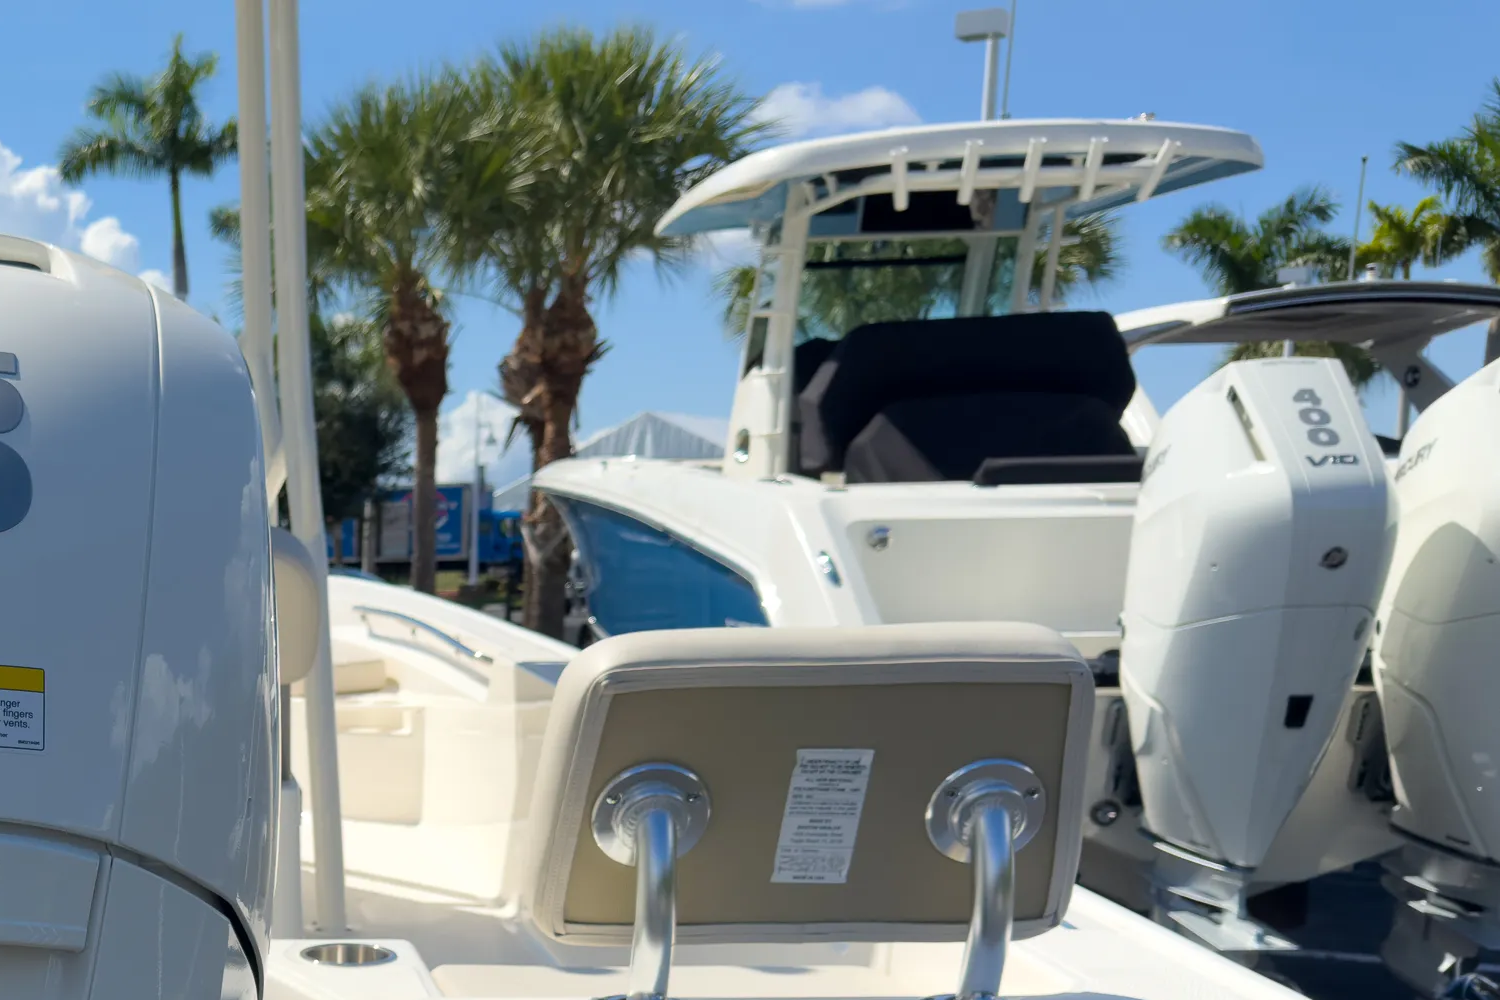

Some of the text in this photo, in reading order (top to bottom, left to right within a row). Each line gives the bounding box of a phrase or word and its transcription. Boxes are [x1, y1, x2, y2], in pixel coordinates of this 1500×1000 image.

[1292, 388, 1340, 447] 400
[2, 708, 33, 720] fingers
[4, 719, 30, 729] vents.
